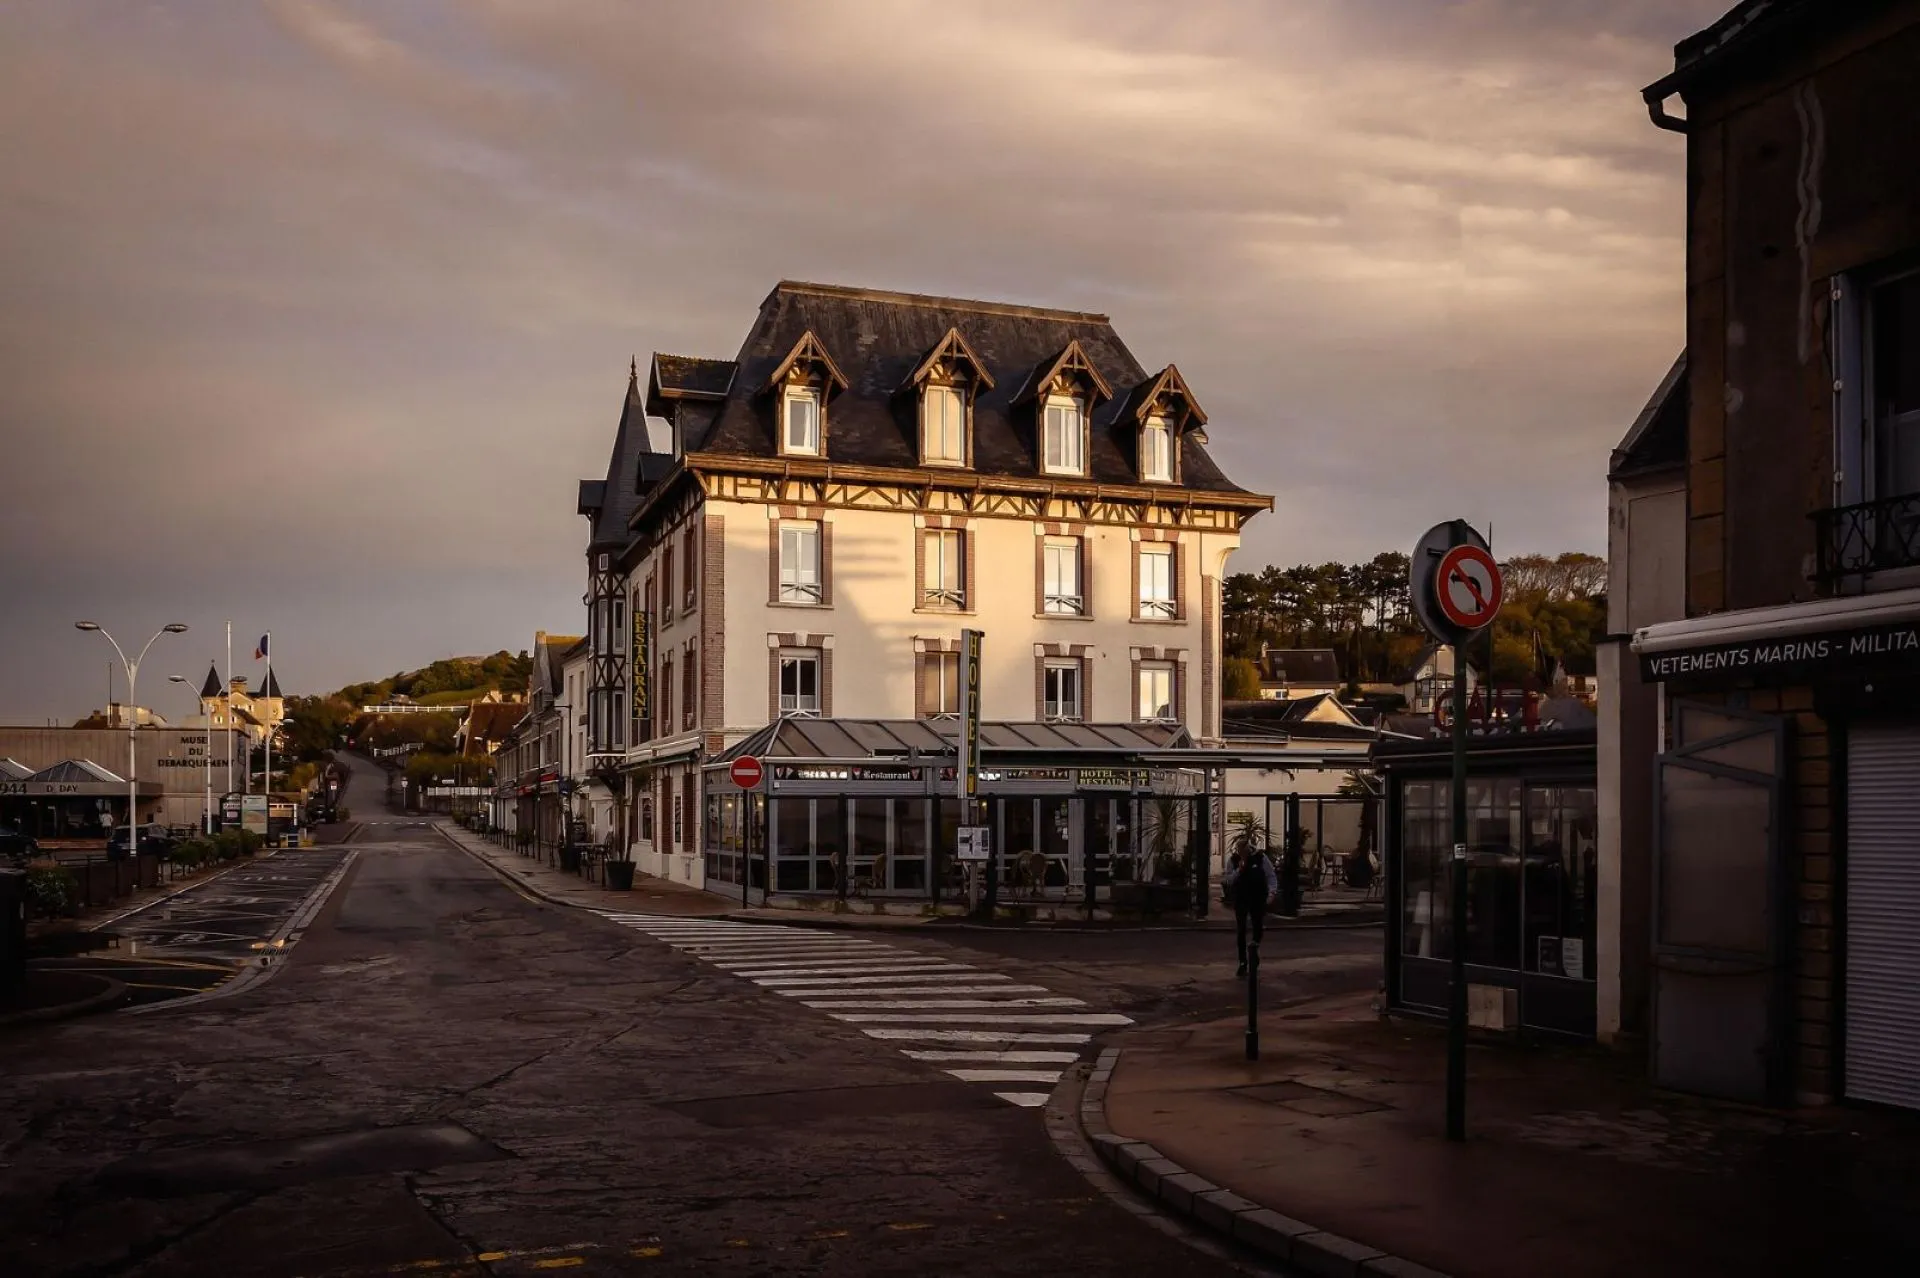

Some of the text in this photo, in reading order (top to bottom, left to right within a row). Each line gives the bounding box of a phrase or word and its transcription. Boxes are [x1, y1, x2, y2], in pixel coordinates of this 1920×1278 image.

[633, 612, 648, 718] RESTAURANT
[1650, 650, 1749, 675] VETEMENTS
[1754, 640, 1829, 664] MARINS
[967, 635, 978, 768] HOTEL
[1080, 769, 1116, 777] HOTEL
